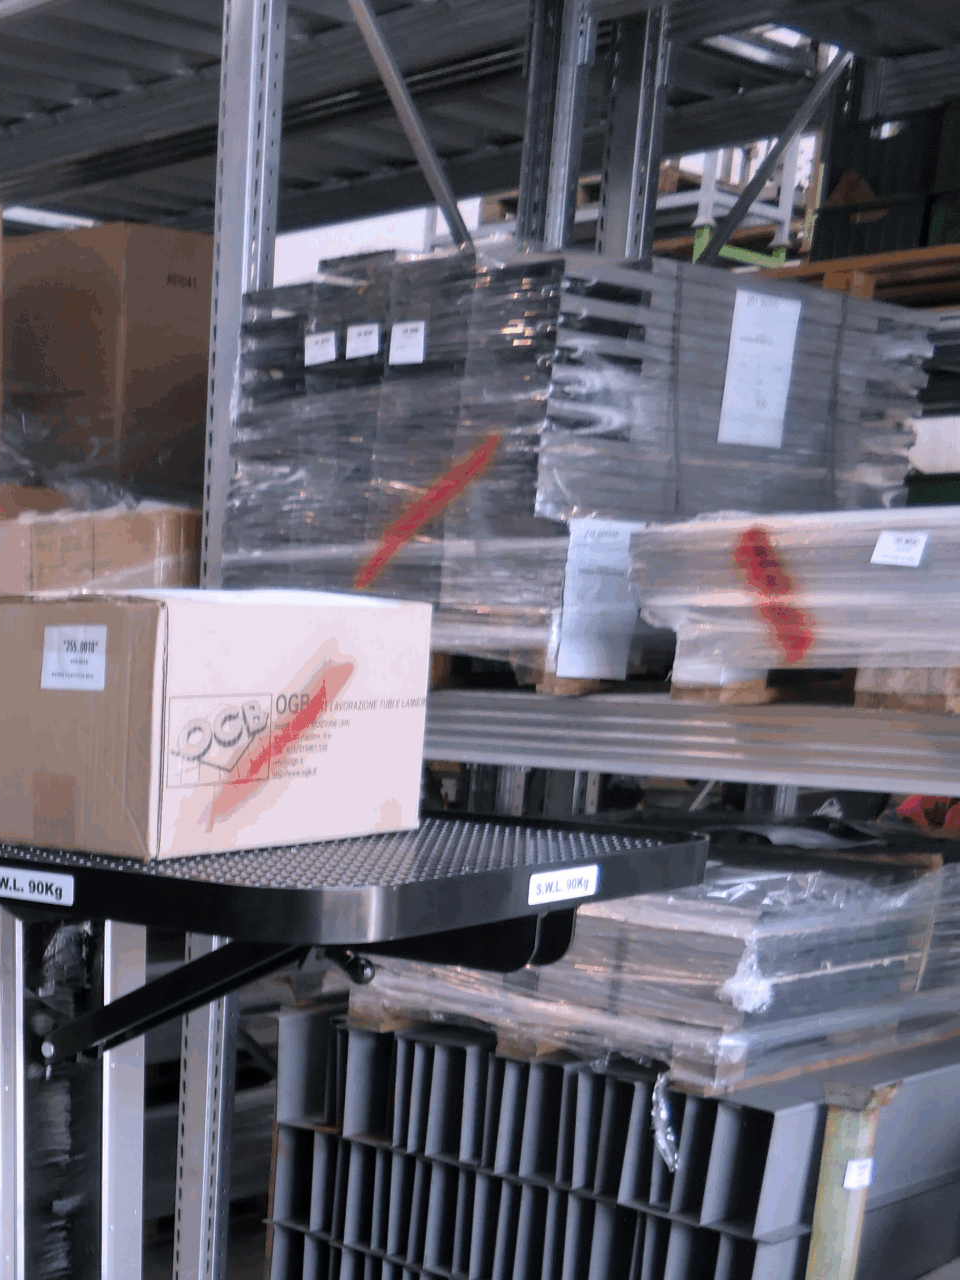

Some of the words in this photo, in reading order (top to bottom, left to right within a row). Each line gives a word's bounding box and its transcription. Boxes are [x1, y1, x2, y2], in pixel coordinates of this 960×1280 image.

[28, 880, 63, 901] 90Kg
[535, 880, 564, 896] S.W.L.
[566, 876, 589, 891] 90Kg
